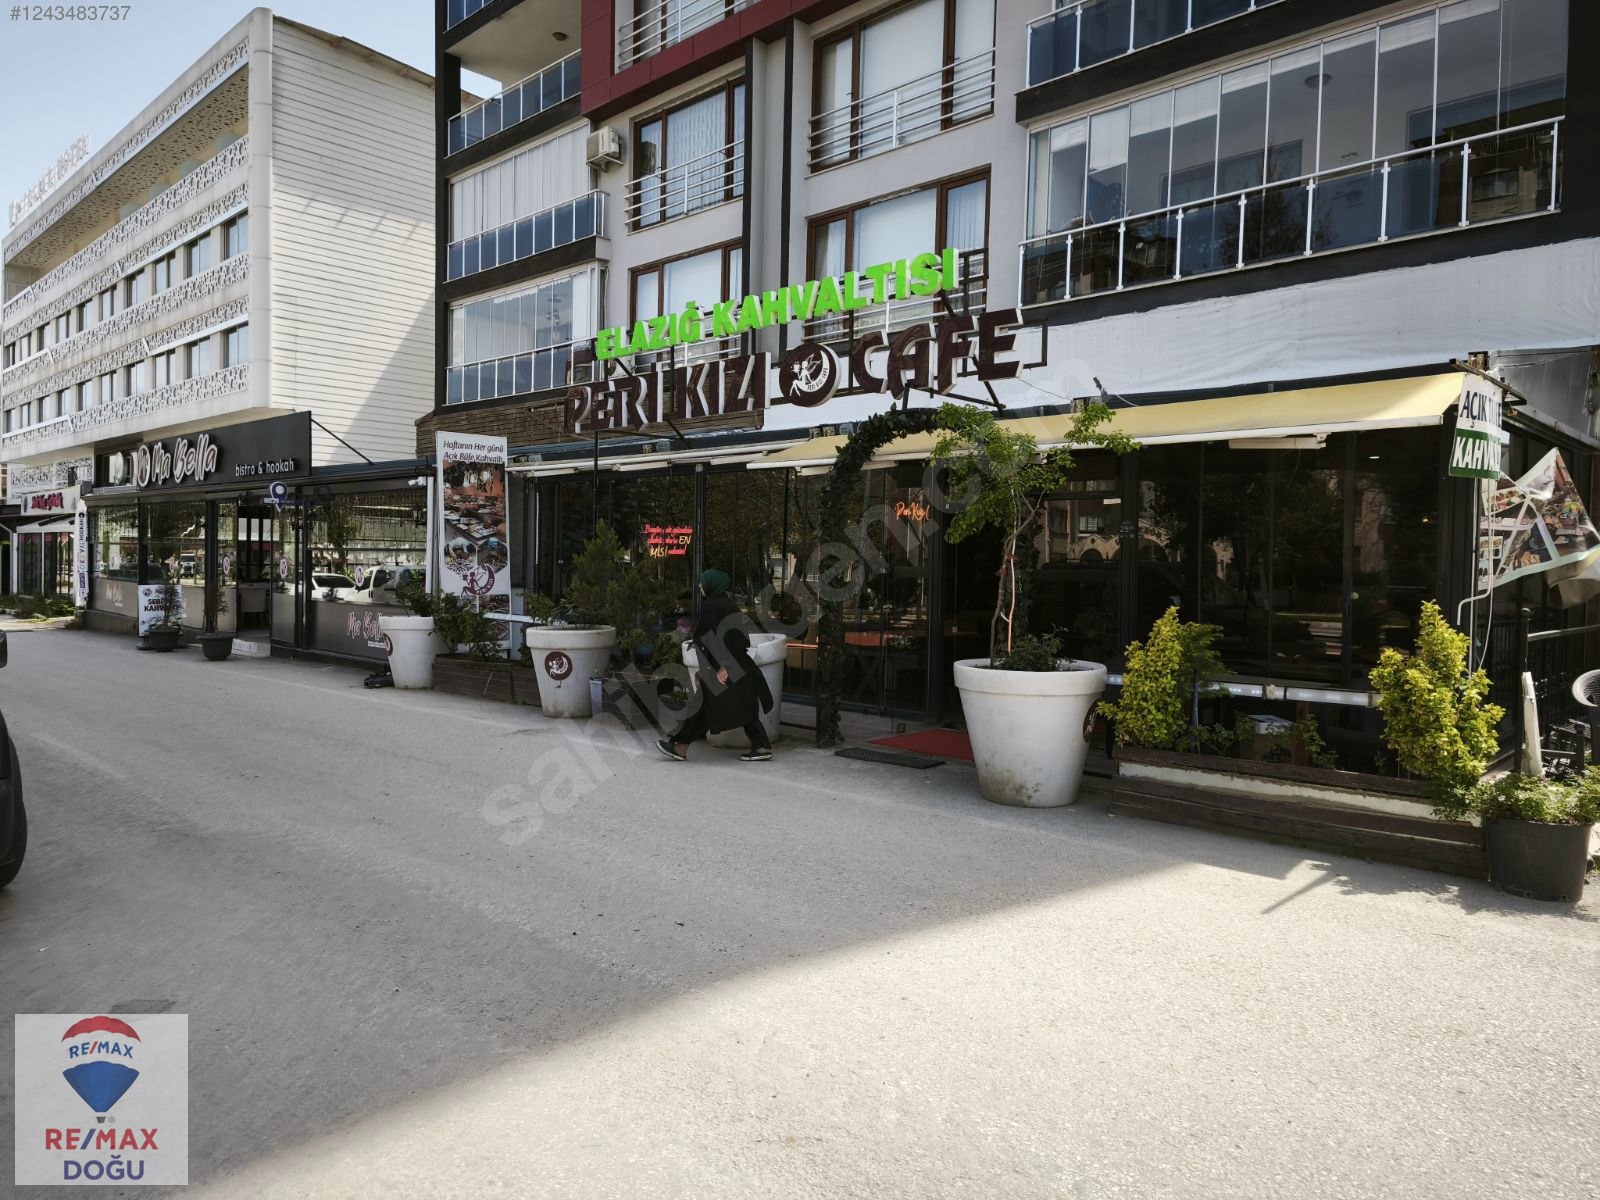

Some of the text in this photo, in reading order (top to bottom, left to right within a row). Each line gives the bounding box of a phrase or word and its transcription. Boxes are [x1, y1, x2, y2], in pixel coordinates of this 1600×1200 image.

[597, 247, 960, 360] ELAZIĞ KAHVALTISI
[676, 352, 771, 420] KIZI
[852, 307, 1024, 400] CAFE
[1460, 390, 1487, 428] AÇIK
[151, 433, 218, 485] Ma Bella
[443, 441, 504, 453] Haftanın Her günü
[444, 452, 458, 460] Açık
[235, 458, 295, 477] bistro & hookah
[679, 535, 691, 545] EN
